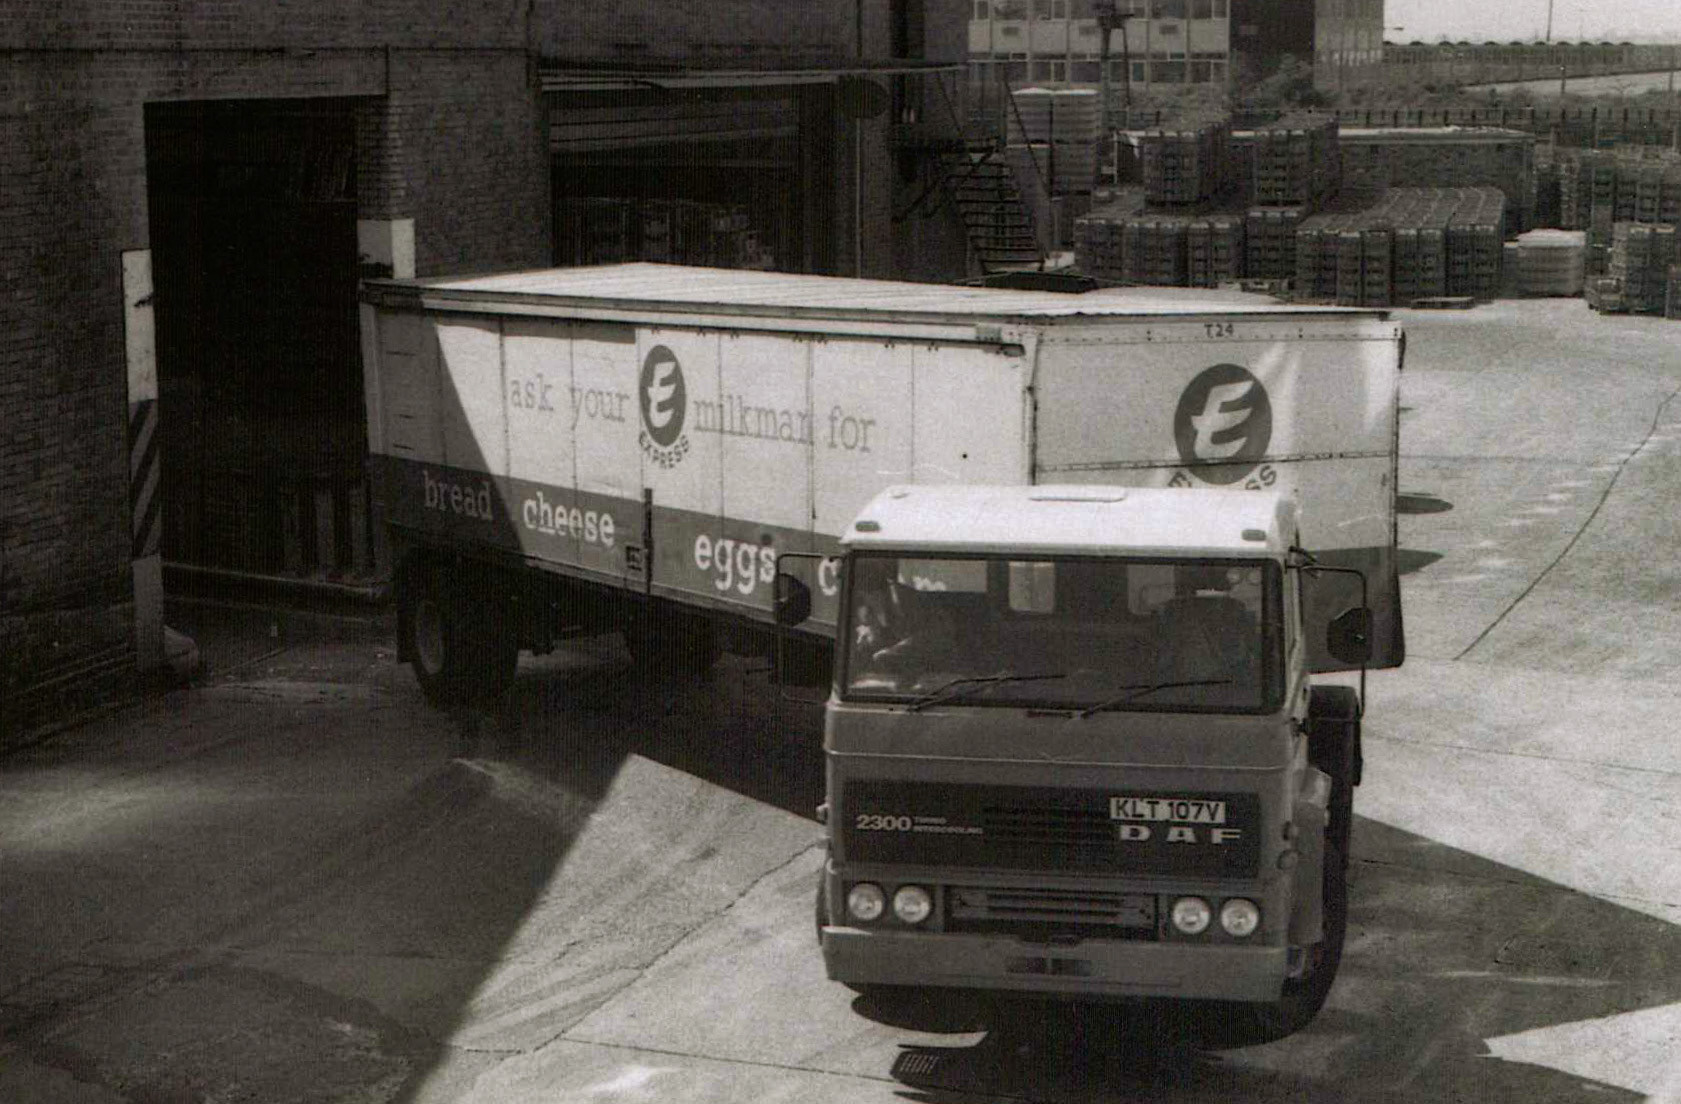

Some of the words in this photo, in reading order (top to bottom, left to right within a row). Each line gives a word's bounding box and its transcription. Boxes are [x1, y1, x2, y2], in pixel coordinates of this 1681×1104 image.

[1204, 323, 1235, 338] T24
[511, 372, 554, 412] ask
[568, 386, 631, 432] your
[828, 404, 877, 453] for
[422, 470, 493, 521] bread
[523, 490, 616, 548] cheese
[694, 534, 777, 595] eggs
[1115, 800, 1160, 819] KLT
[855, 814, 913, 831] 2300
[1119, 824, 1242, 844] DAF
